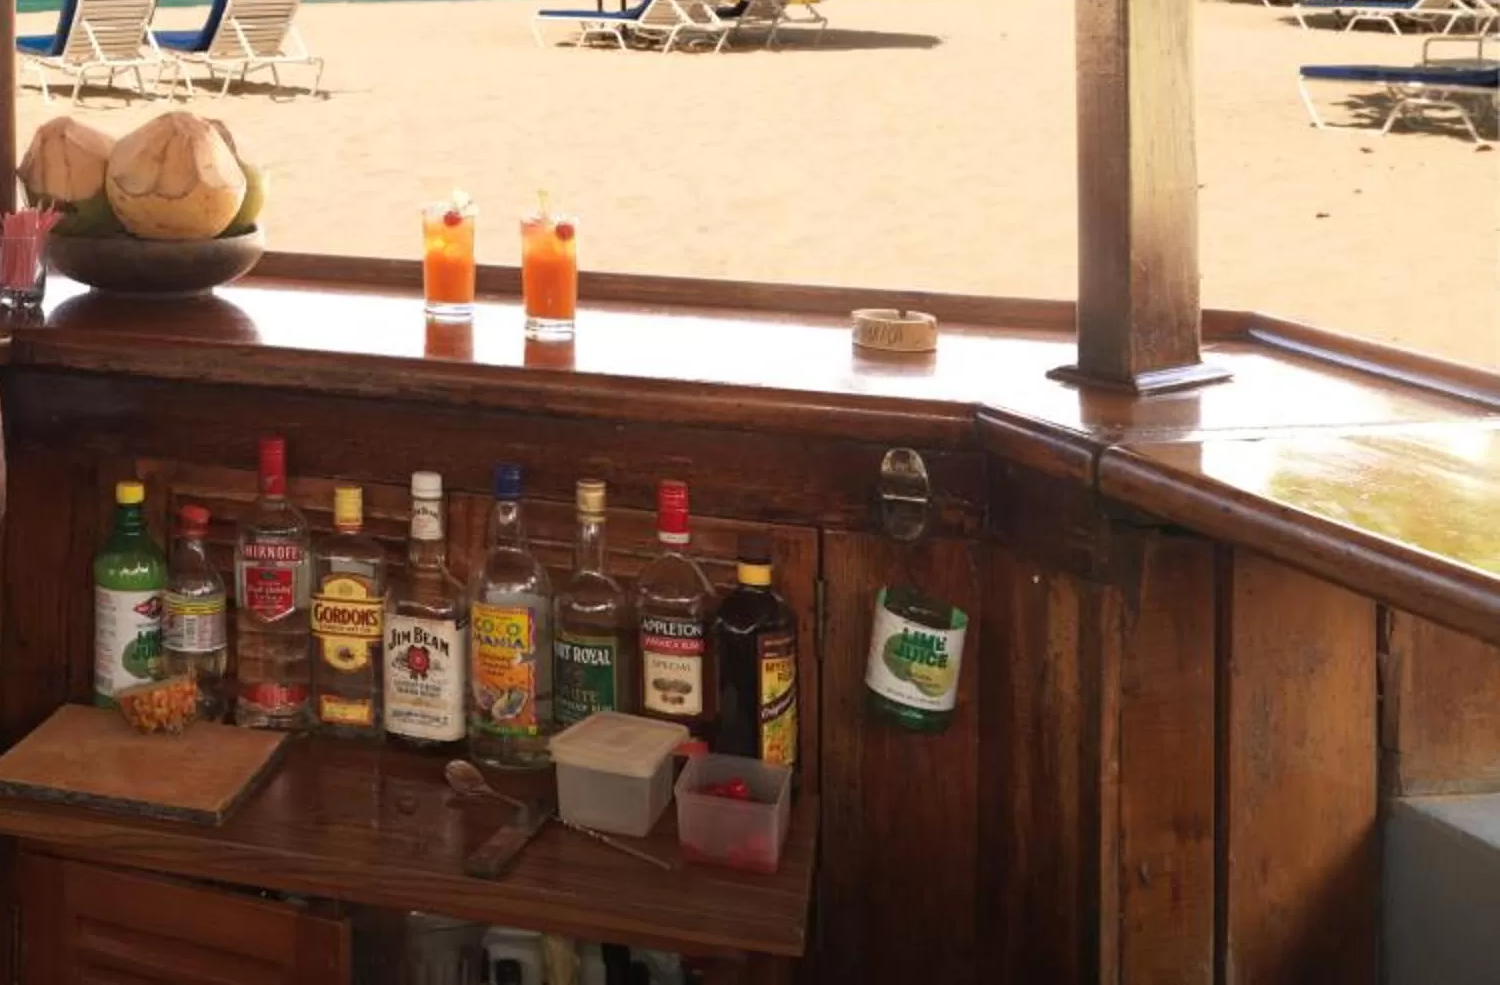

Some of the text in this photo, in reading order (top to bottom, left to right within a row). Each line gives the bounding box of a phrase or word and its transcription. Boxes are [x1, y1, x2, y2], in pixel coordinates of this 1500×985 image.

[388, 626, 450, 657] JIM BEAM
[901, 626, 947, 652] LIME
[573, 645, 612, 666] ROYAL
[893, 644, 948, 669] JUICE
